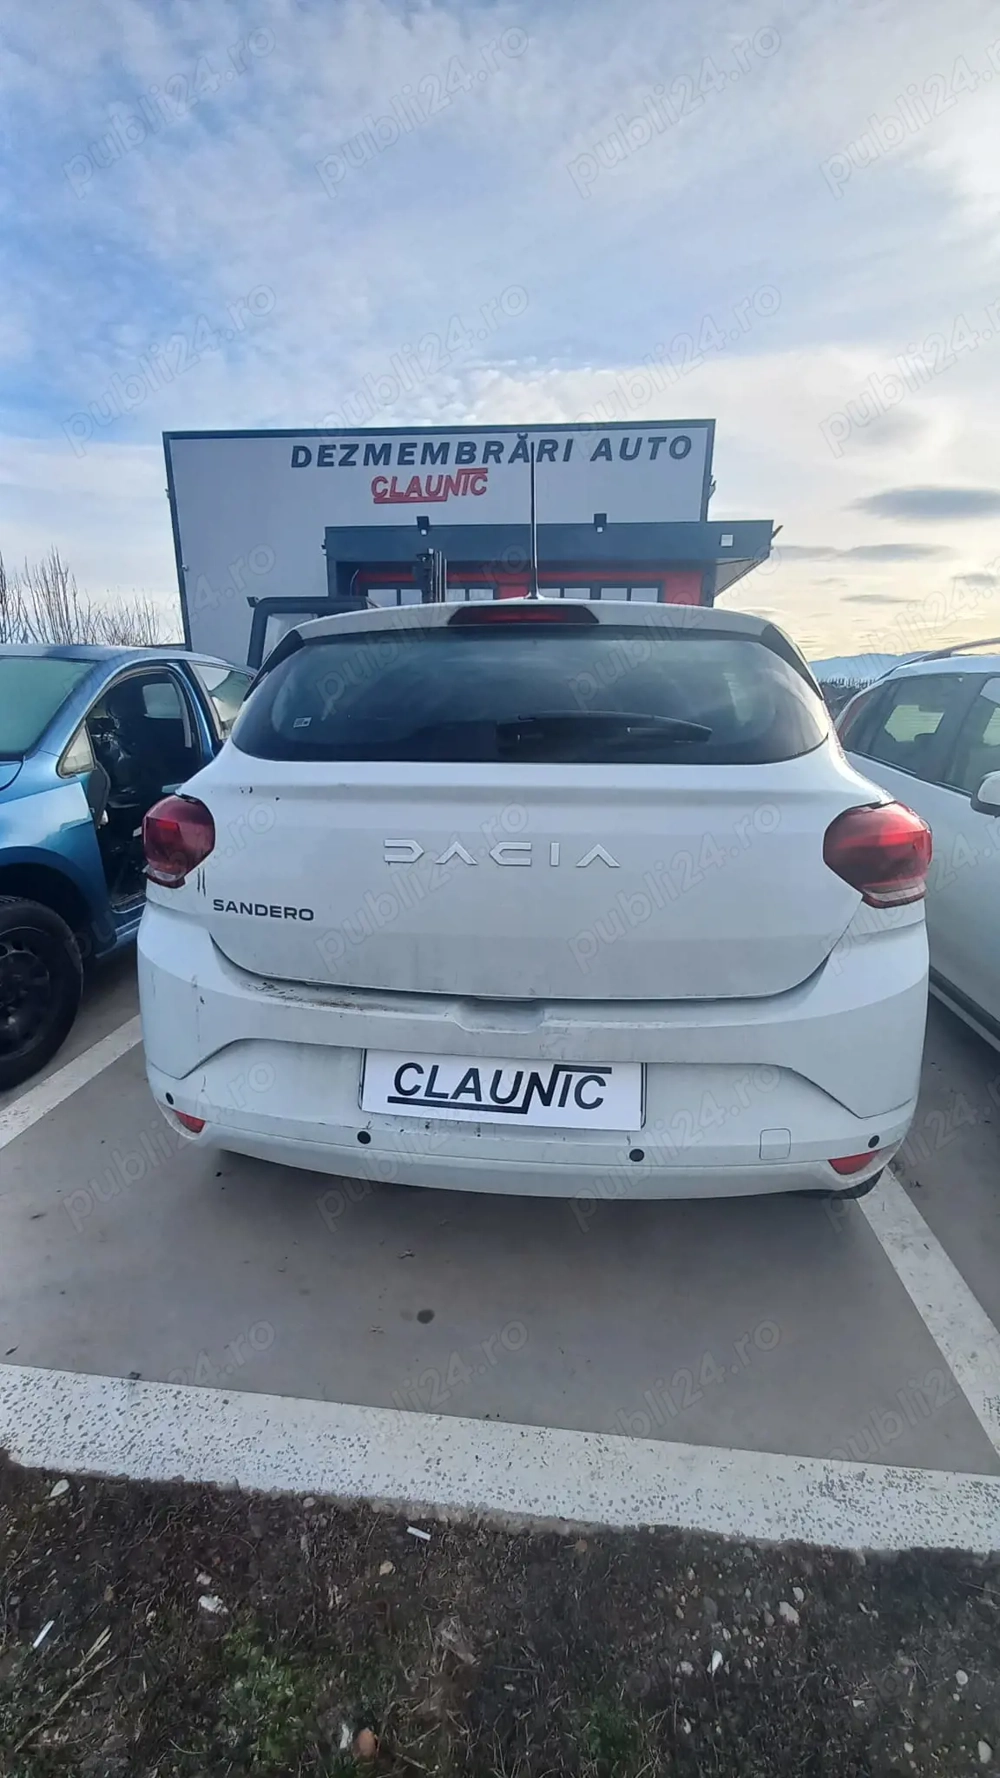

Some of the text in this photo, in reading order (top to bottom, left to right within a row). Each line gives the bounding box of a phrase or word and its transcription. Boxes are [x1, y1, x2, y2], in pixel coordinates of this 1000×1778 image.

[291, 433, 692, 468] DEZMEMBRĂRI AUTO
[371, 468, 488, 504] CLAUNIC
[384, 838, 621, 868] DACIA
[213, 899, 314, 921] SANDERO
[387, 1062, 612, 1115] CLAUNIC
